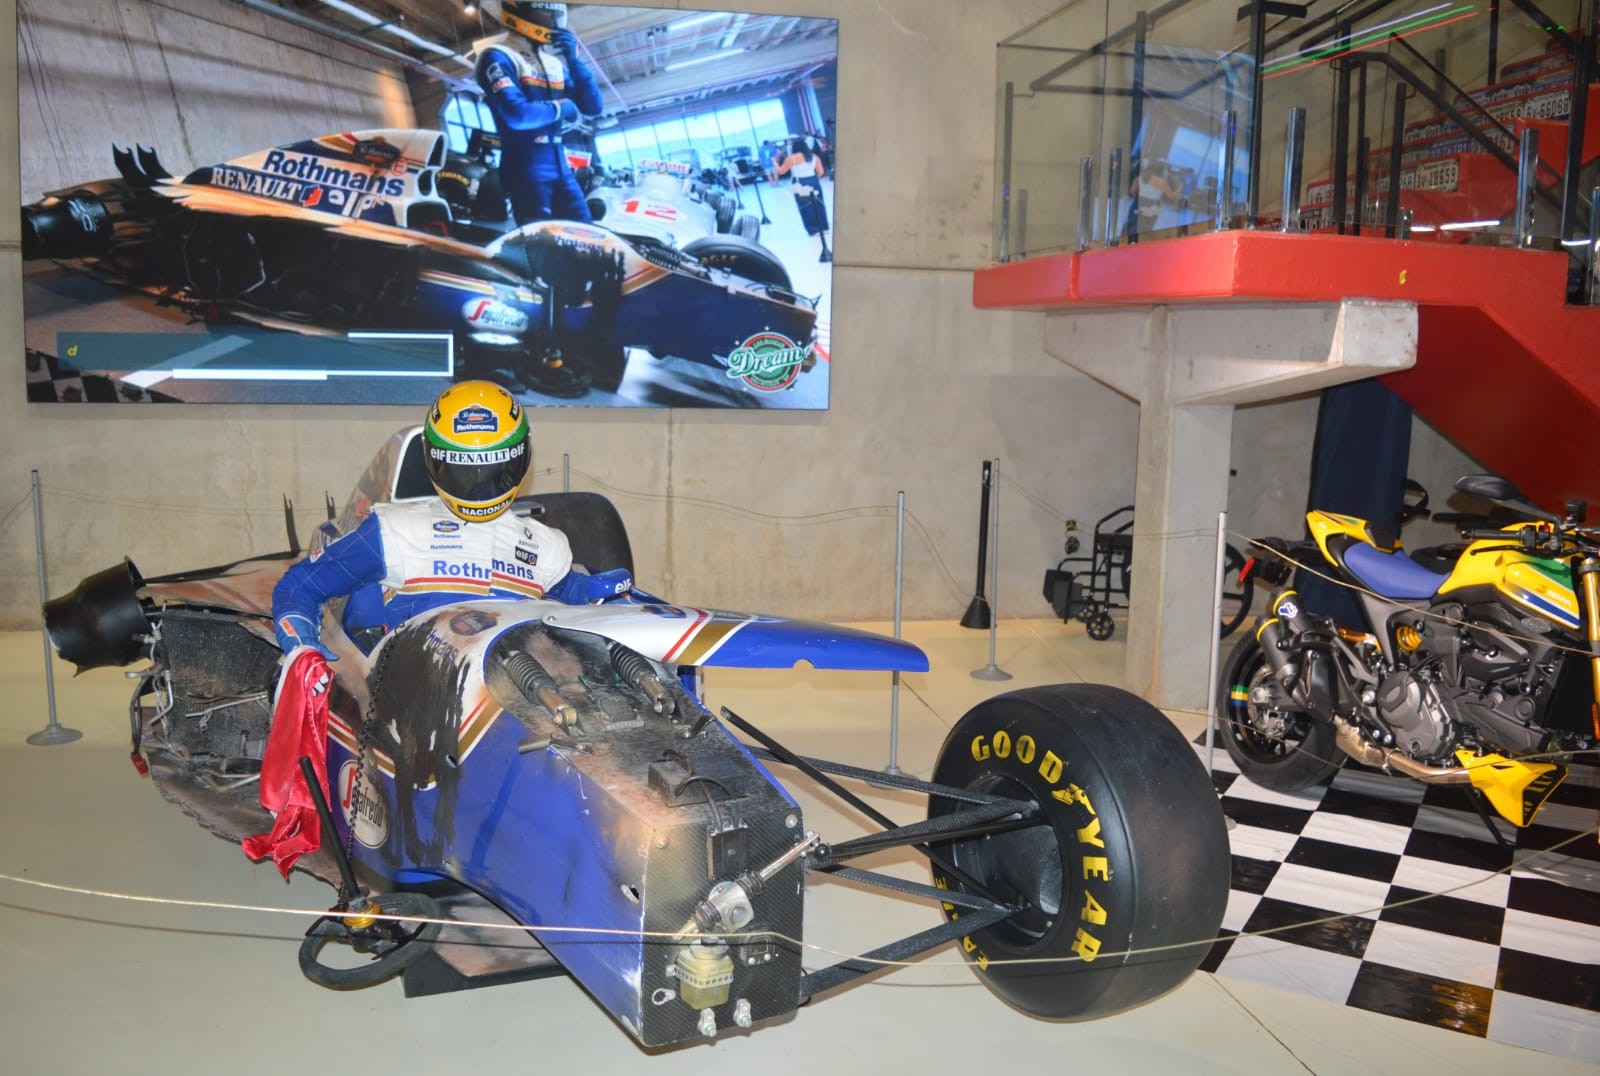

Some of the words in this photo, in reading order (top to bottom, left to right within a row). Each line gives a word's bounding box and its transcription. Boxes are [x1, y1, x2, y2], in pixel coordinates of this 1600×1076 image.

[209, 166, 302, 201] RENAULT
[261, 149, 405, 197] Rothmans
[727, 346, 804, 379] Dream
[456, 423, 495, 432] Rothmans
[449, 450, 509, 463] RENAULT
[970, 730, 1109, 963] GOODYEAR
